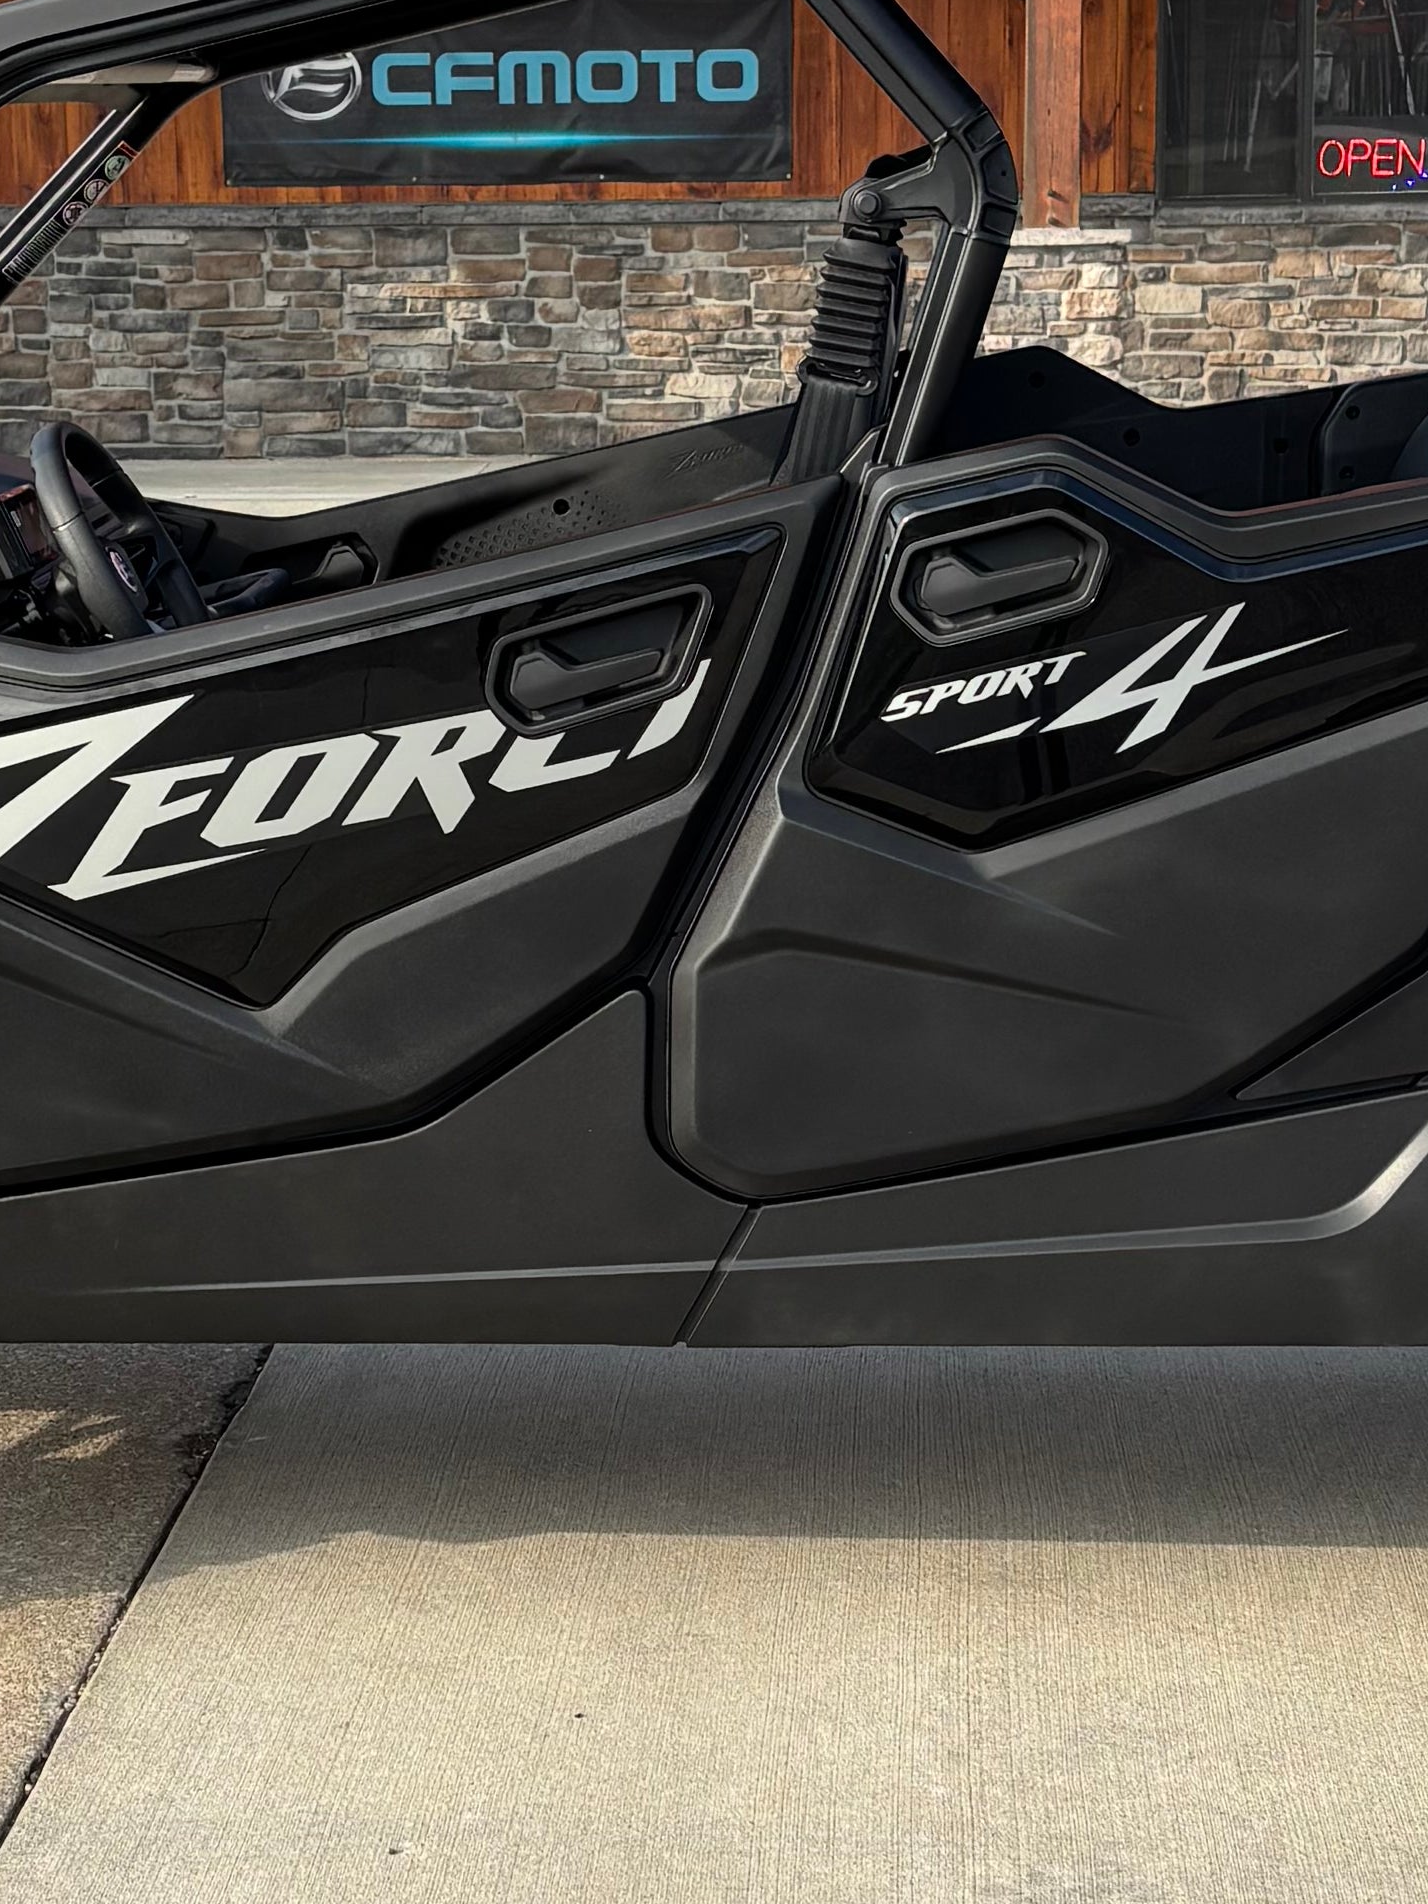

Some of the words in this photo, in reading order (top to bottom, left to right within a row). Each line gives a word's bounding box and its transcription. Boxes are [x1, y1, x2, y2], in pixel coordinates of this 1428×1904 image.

[370, 47, 760, 107] CFMOTO
[1317, 137, 1427, 178] OPEN
[880, 650, 1088, 722] SPORT
